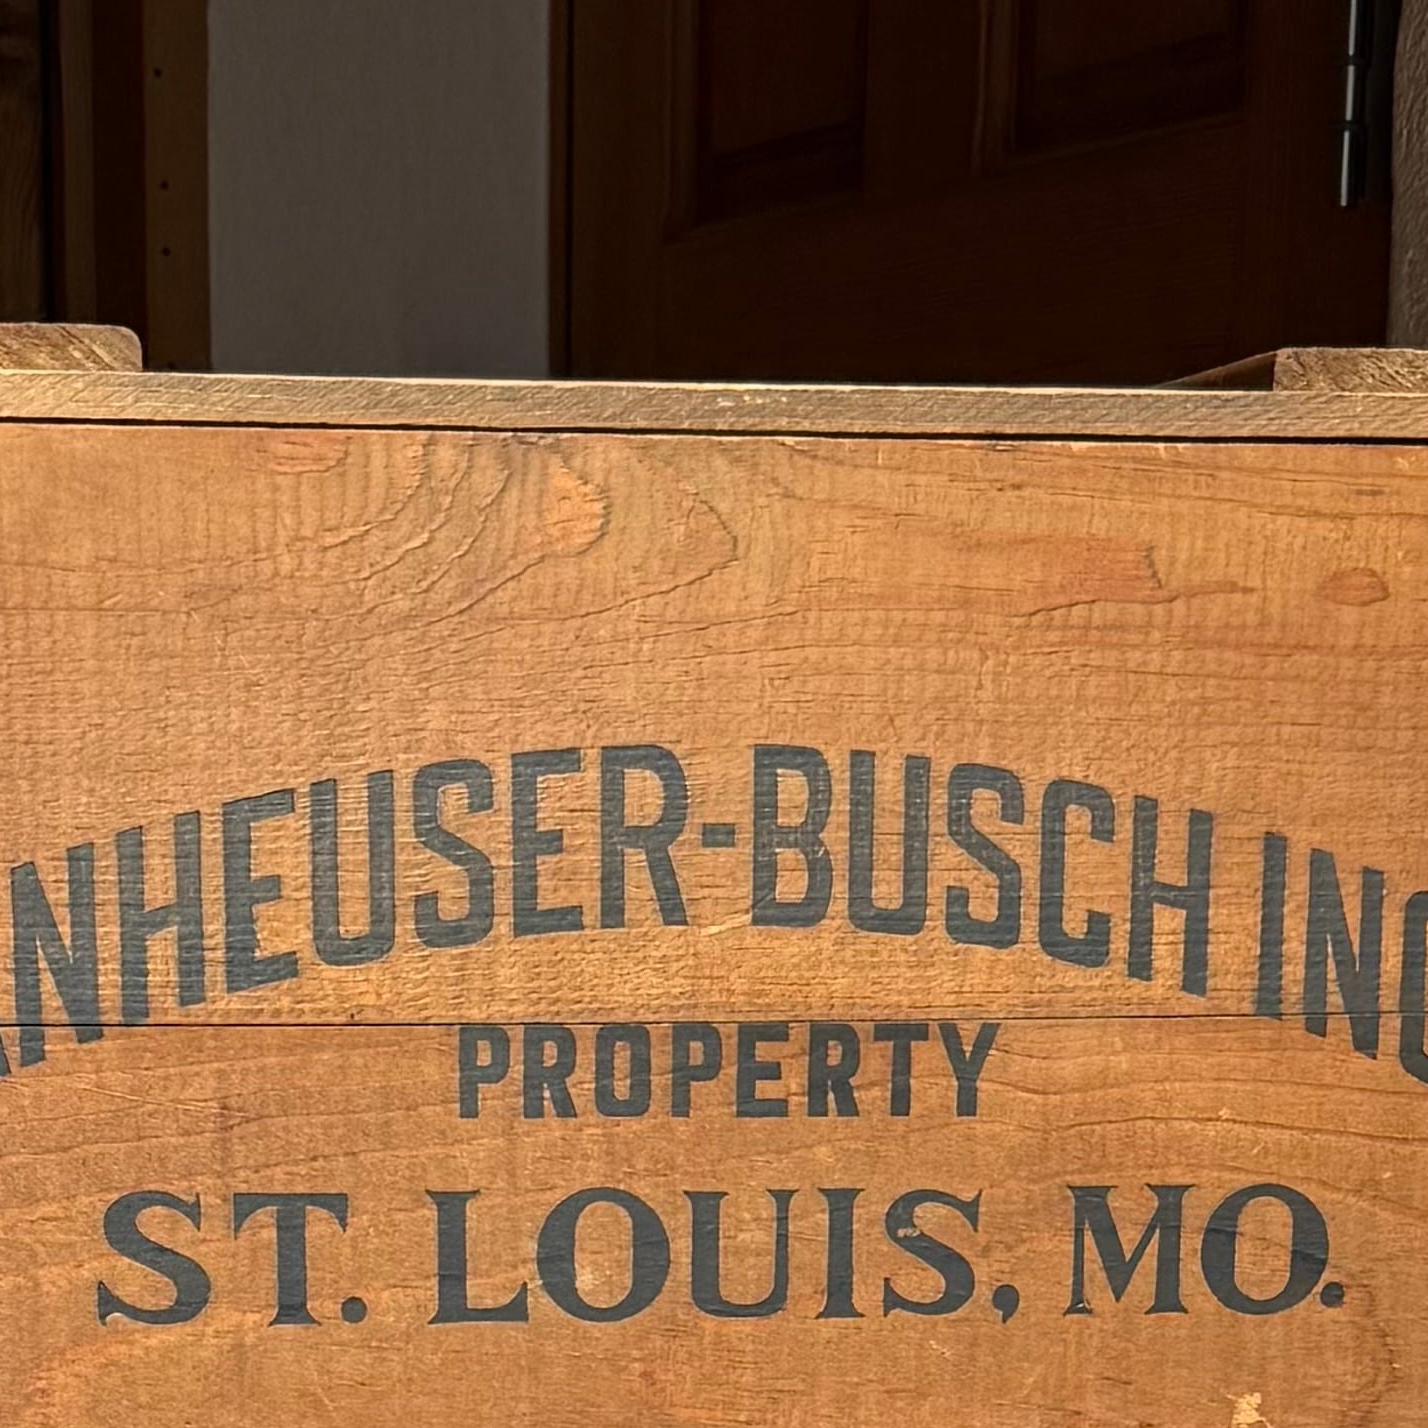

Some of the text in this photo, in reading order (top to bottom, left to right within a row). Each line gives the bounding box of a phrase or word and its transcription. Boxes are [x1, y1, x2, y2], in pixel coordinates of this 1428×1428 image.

[457, 1019, 1002, 1119] PROPERTY
[96, 1183, 1346, 1327] ST. LOUIS, MO.
